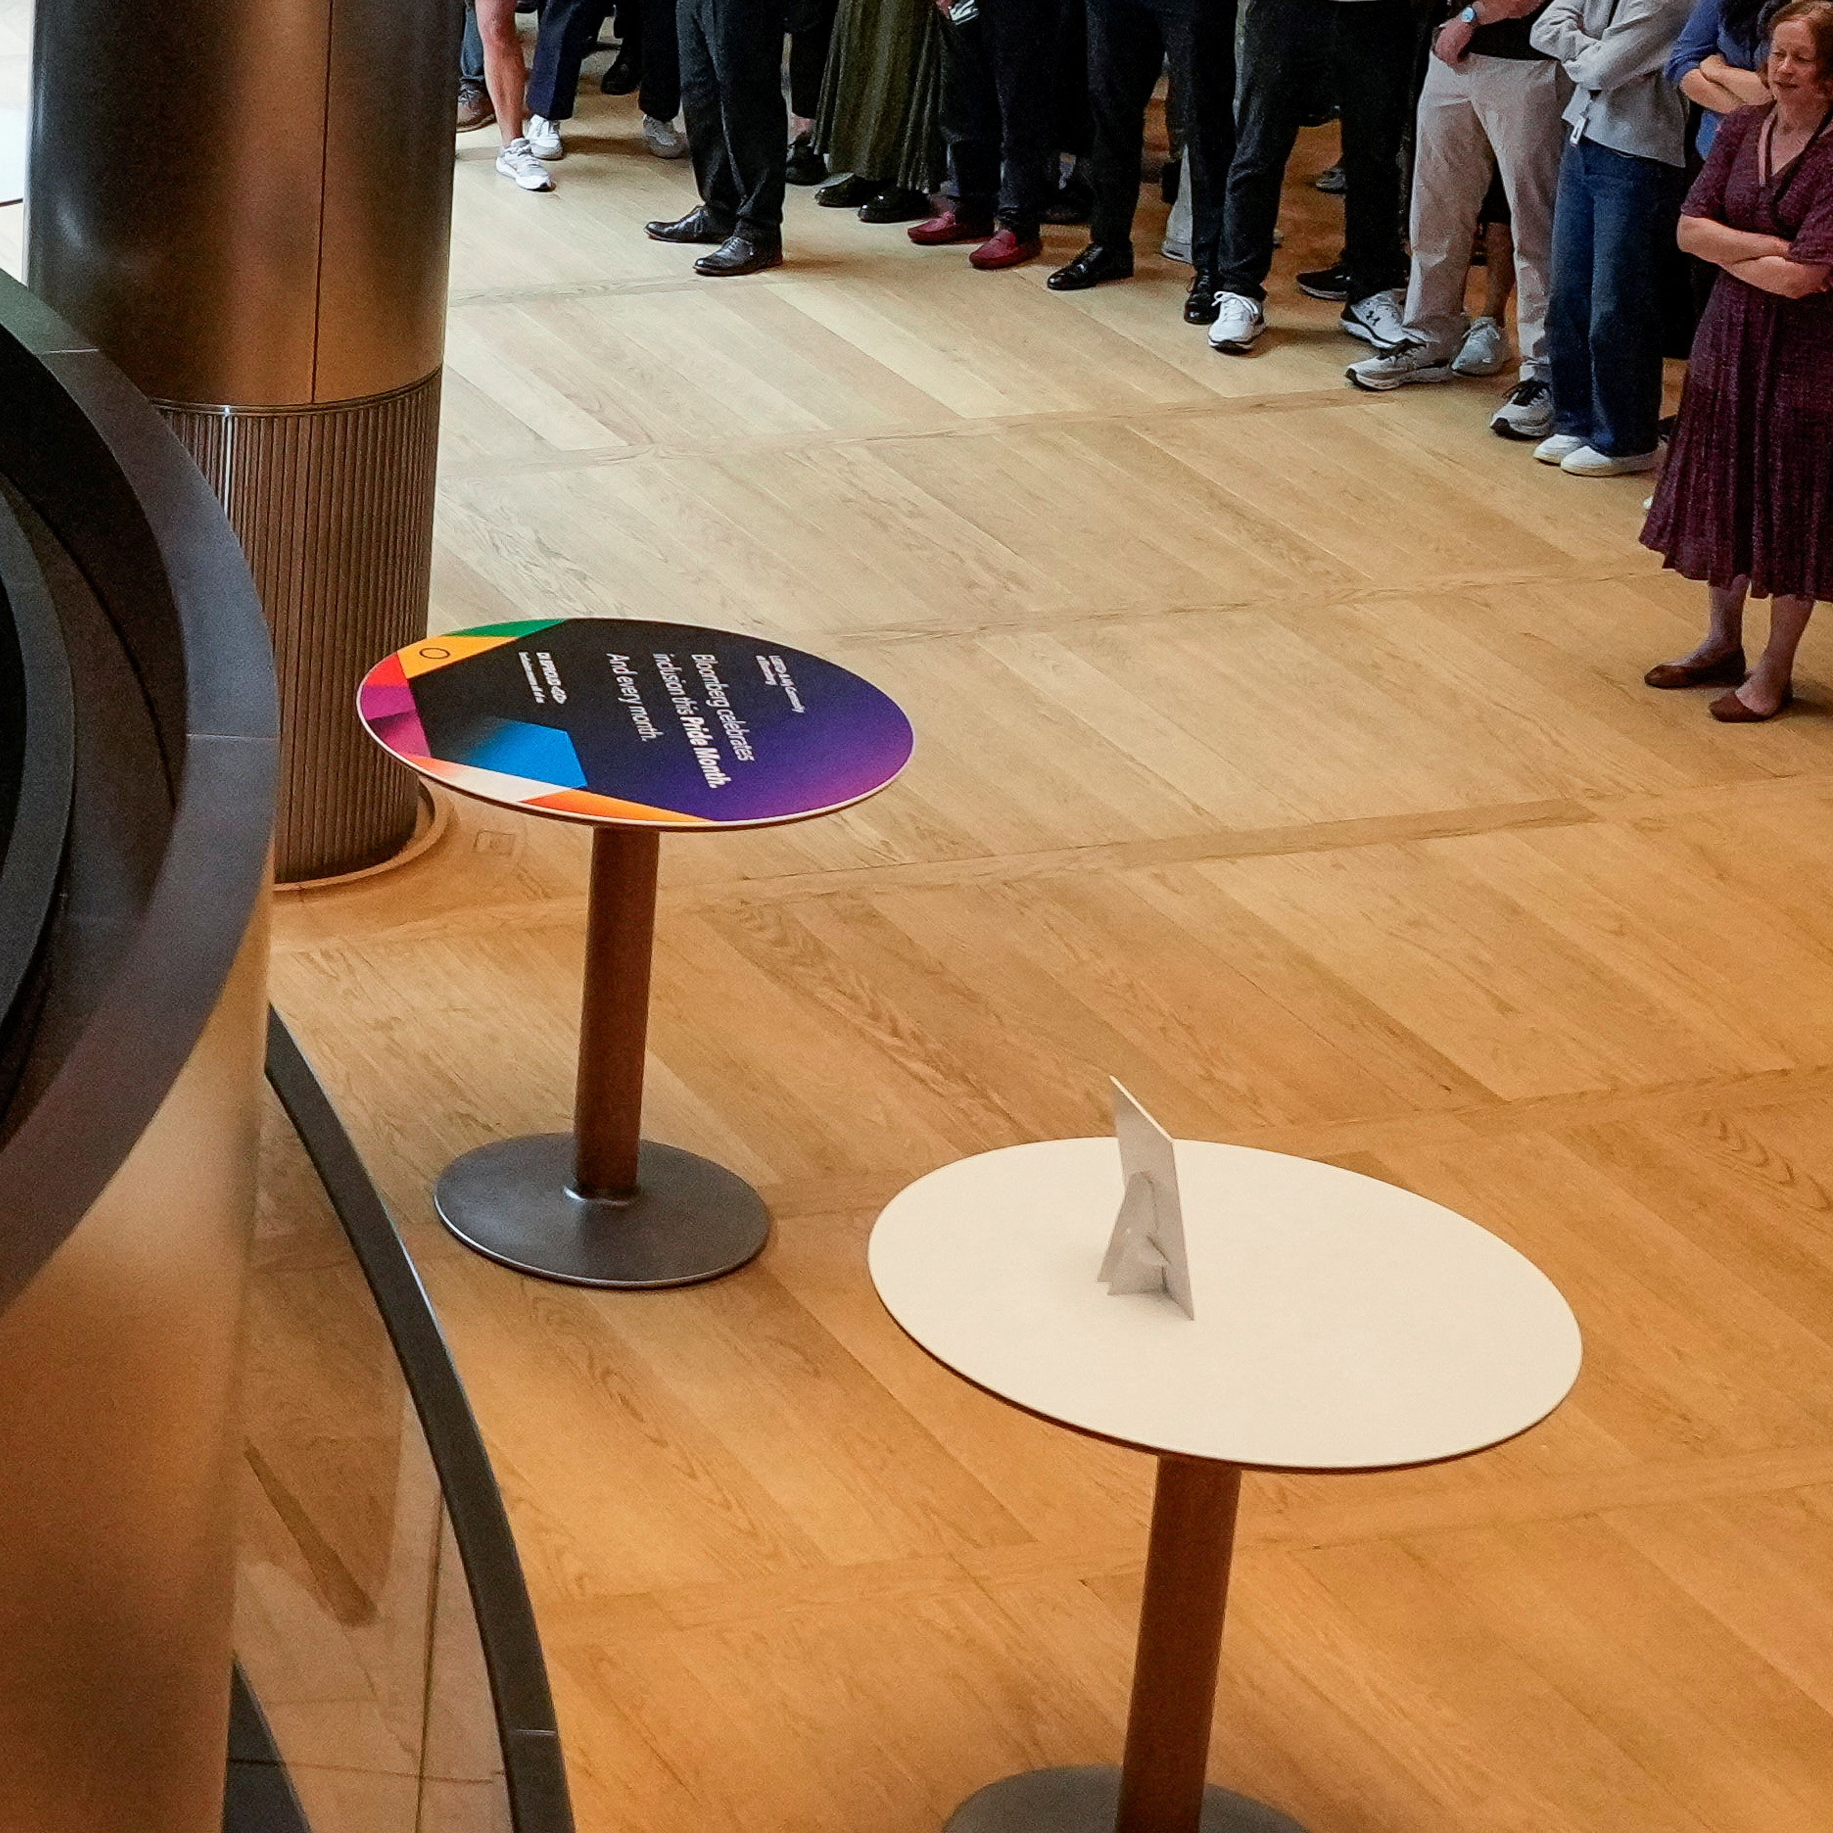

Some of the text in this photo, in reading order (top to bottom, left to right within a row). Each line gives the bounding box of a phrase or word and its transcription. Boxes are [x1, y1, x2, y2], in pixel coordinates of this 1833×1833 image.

[606, 653, 664, 742] And every month.
[653, 653, 732, 789] inclusion this Pride Month.
[691, 654, 755, 762] Bloomberg celebrates
